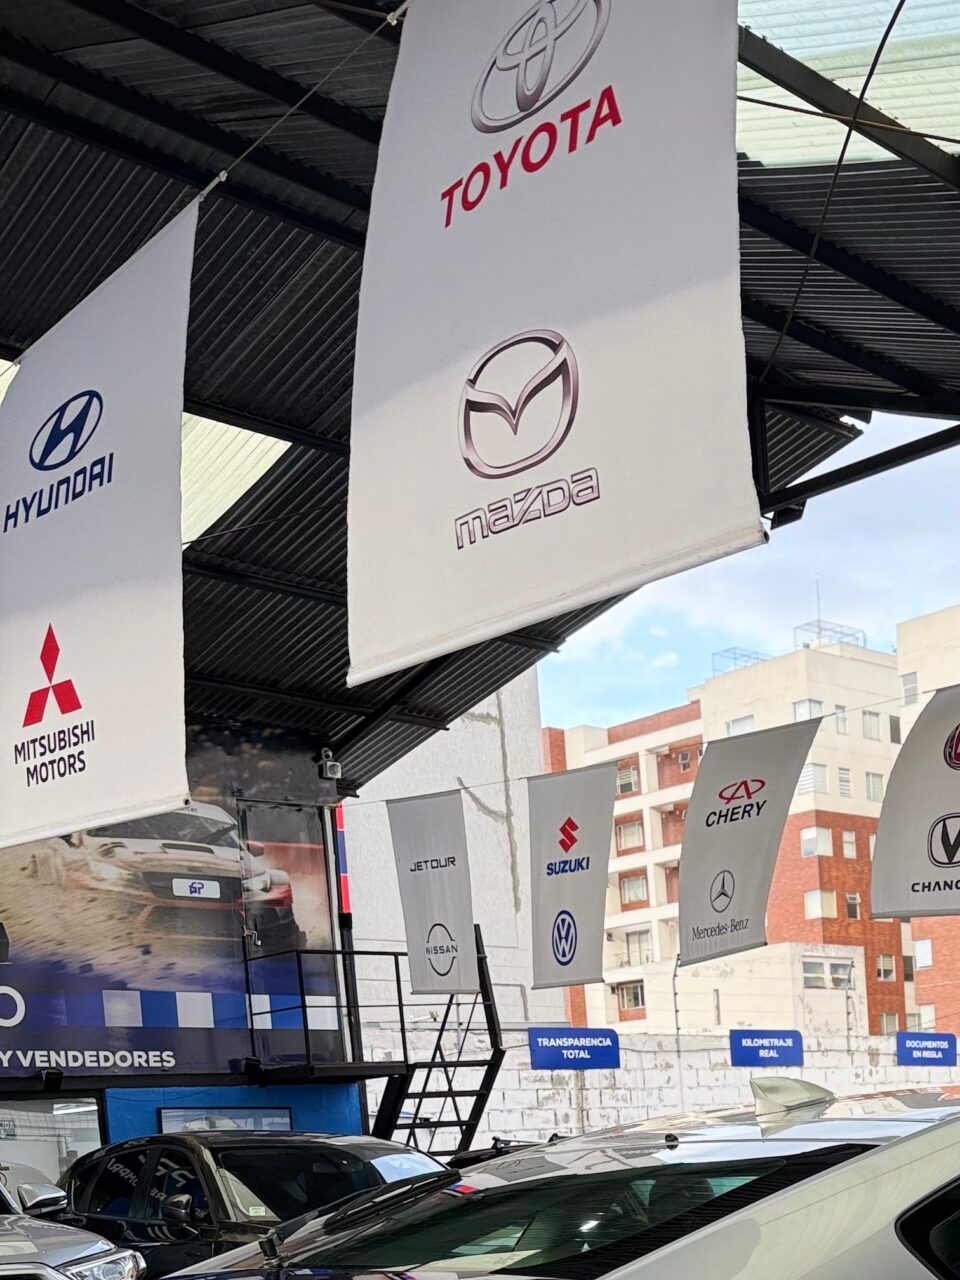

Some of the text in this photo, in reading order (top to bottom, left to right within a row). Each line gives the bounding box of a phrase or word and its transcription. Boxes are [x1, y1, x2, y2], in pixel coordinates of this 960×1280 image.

[440, 84, 622, 229] TOYOTA
[3, 452, 114, 534] HYUNDAI
[14, 719, 95, 765] MITSUBISHI
[26, 750, 86, 787] MOTORS
[705, 800, 767, 828] CHERY
[409, 856, 457, 872] JETOUR
[546, 856, 591, 876] SUZUKI
[691, 918, 749, 941] Mercedes-Benz
[425, 944, 459, 955] NISSAN
[537, 1037, 612, 1047] TRANSPARENCIA
[741, 1038, 793, 1047] KILOMETRAJE
[905, 1040, 949, 1050] DOCUMENTOS
[16, 1050, 176, 1068] VENDEDORES
[562, 1049, 591, 1059] TOTAL
[759, 1049, 779, 1058] REAL
[913, 1050, 943, 1059] EN REGLA
